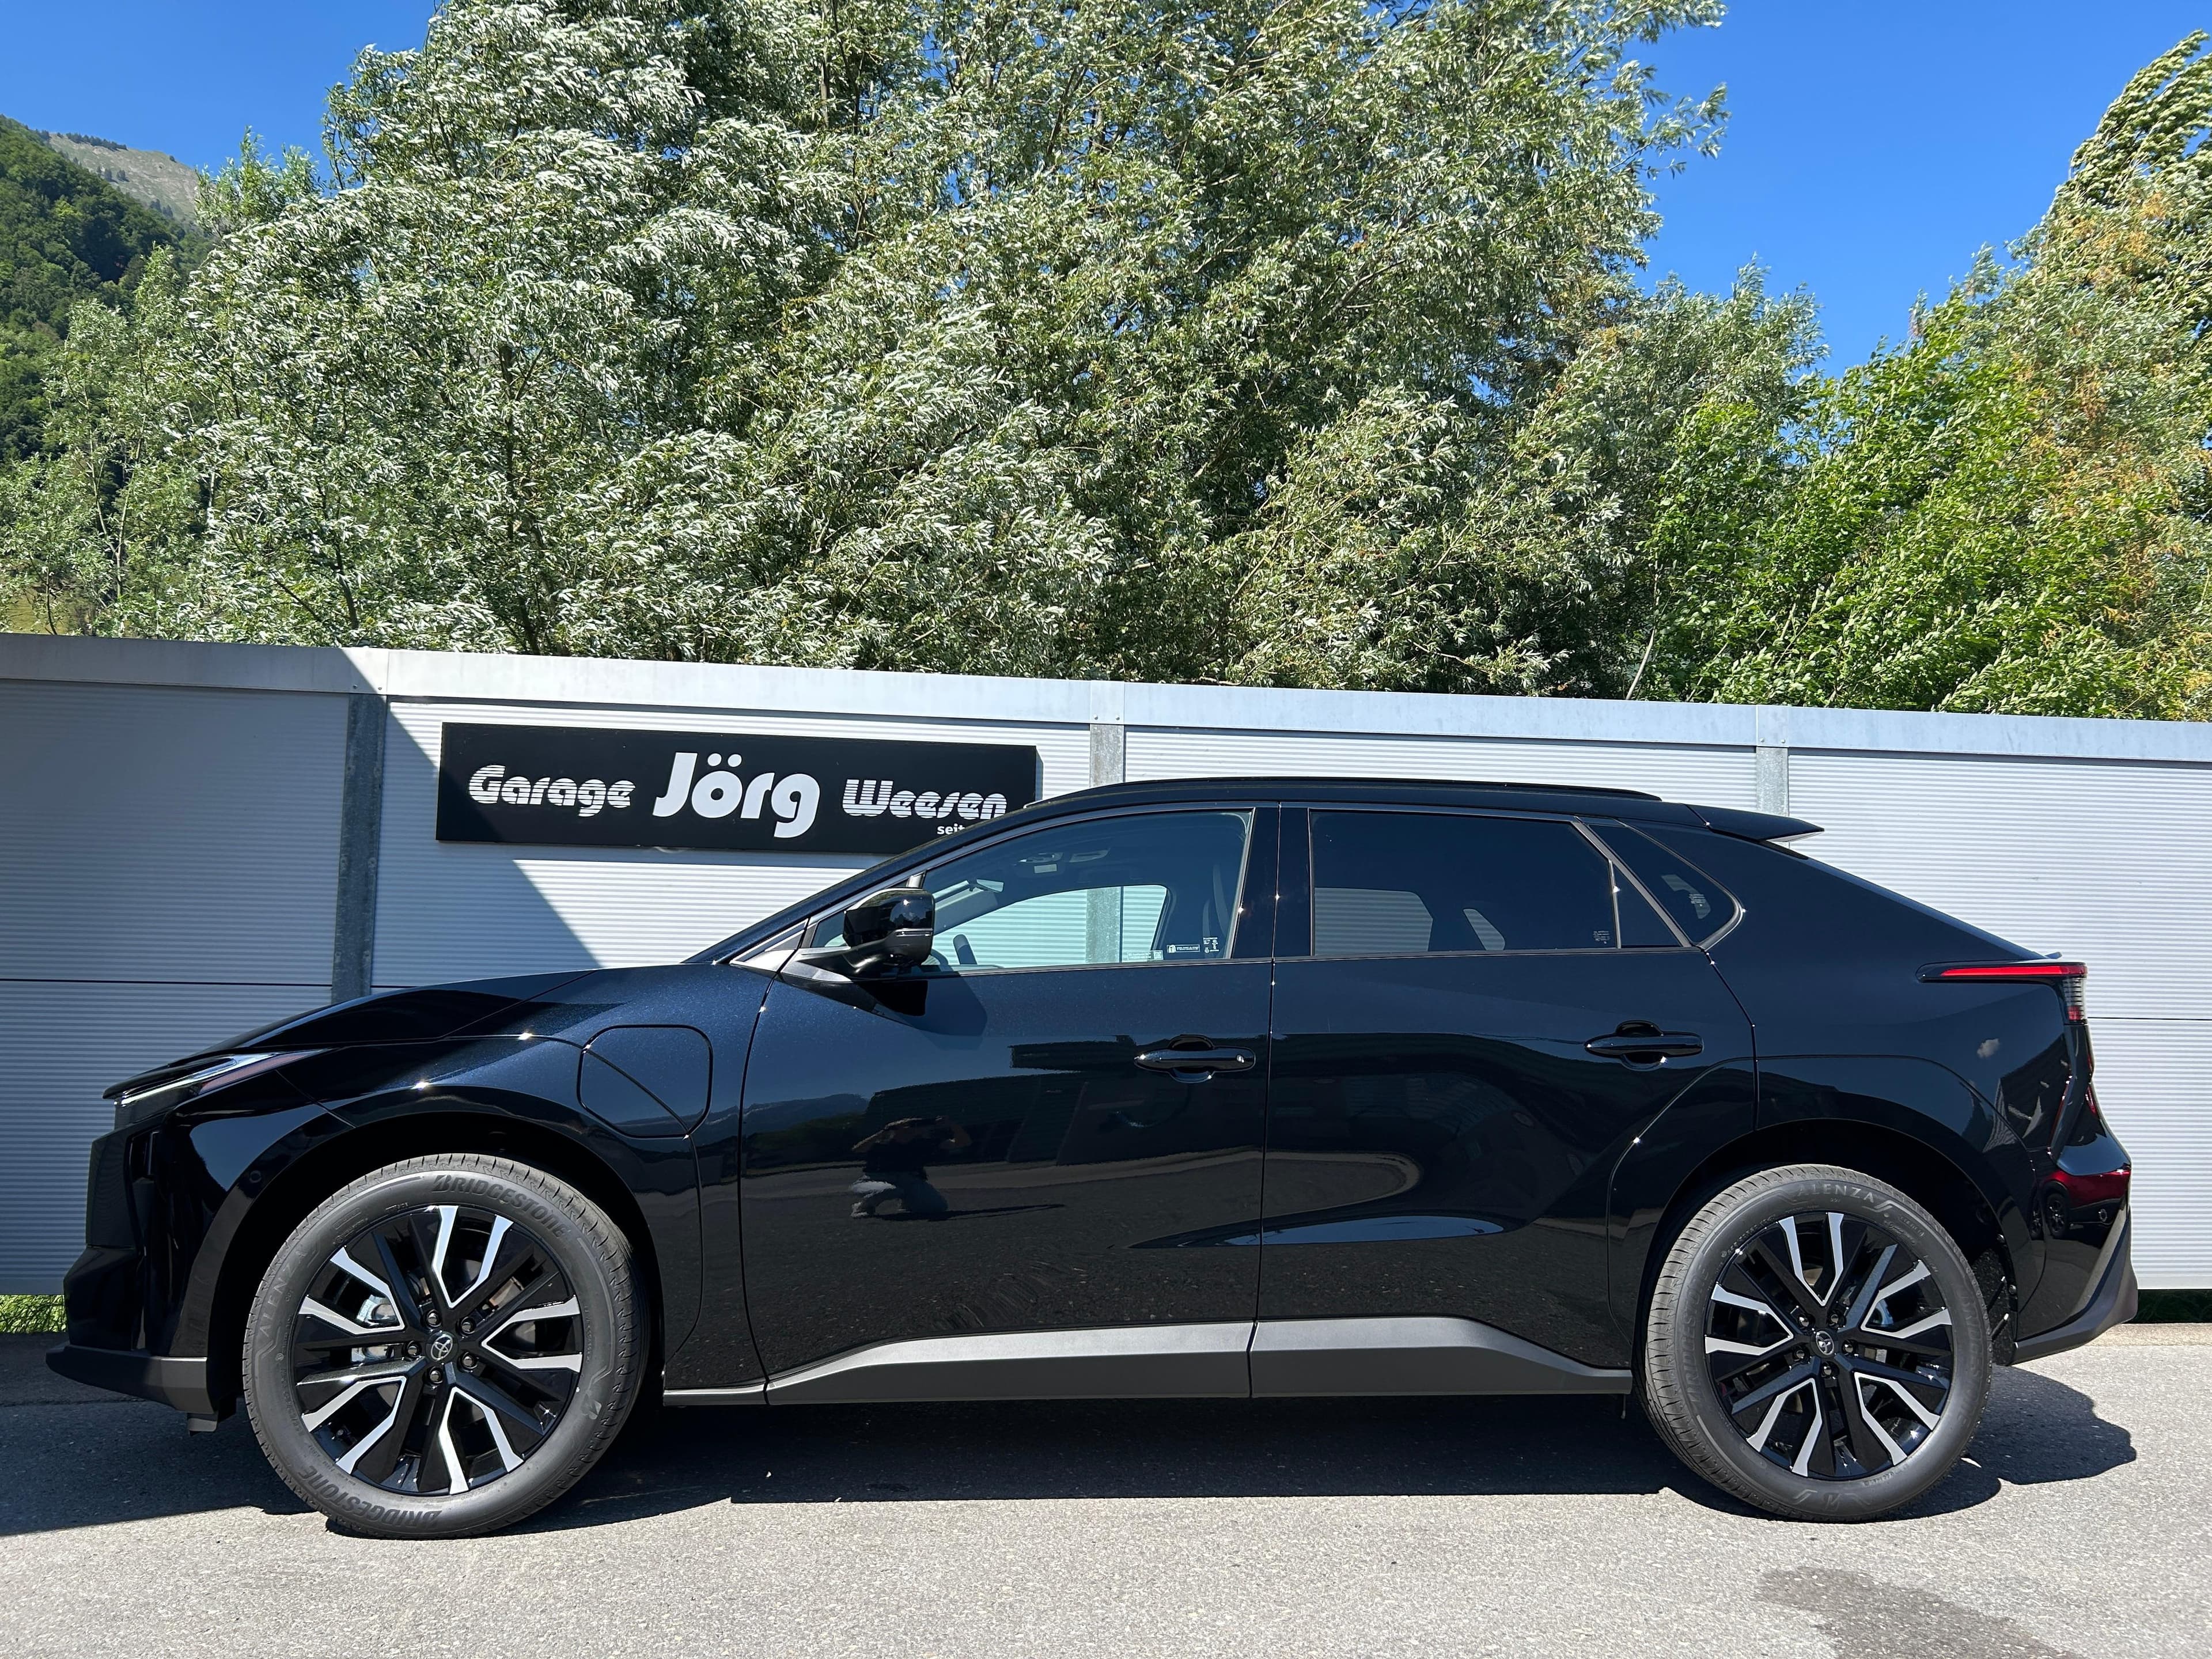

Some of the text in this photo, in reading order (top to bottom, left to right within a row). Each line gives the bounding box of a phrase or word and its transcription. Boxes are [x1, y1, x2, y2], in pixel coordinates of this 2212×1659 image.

[469, 752, 1007, 838] Garage Jörg Weesen
[431, 1174, 569, 1238] BRIDGESTONE
[1798, 1183, 1874, 1203] ALENZA
[259, 1250, 308, 1338] ALENZA
[298, 1465, 442, 1527] BRIDGESTONE
